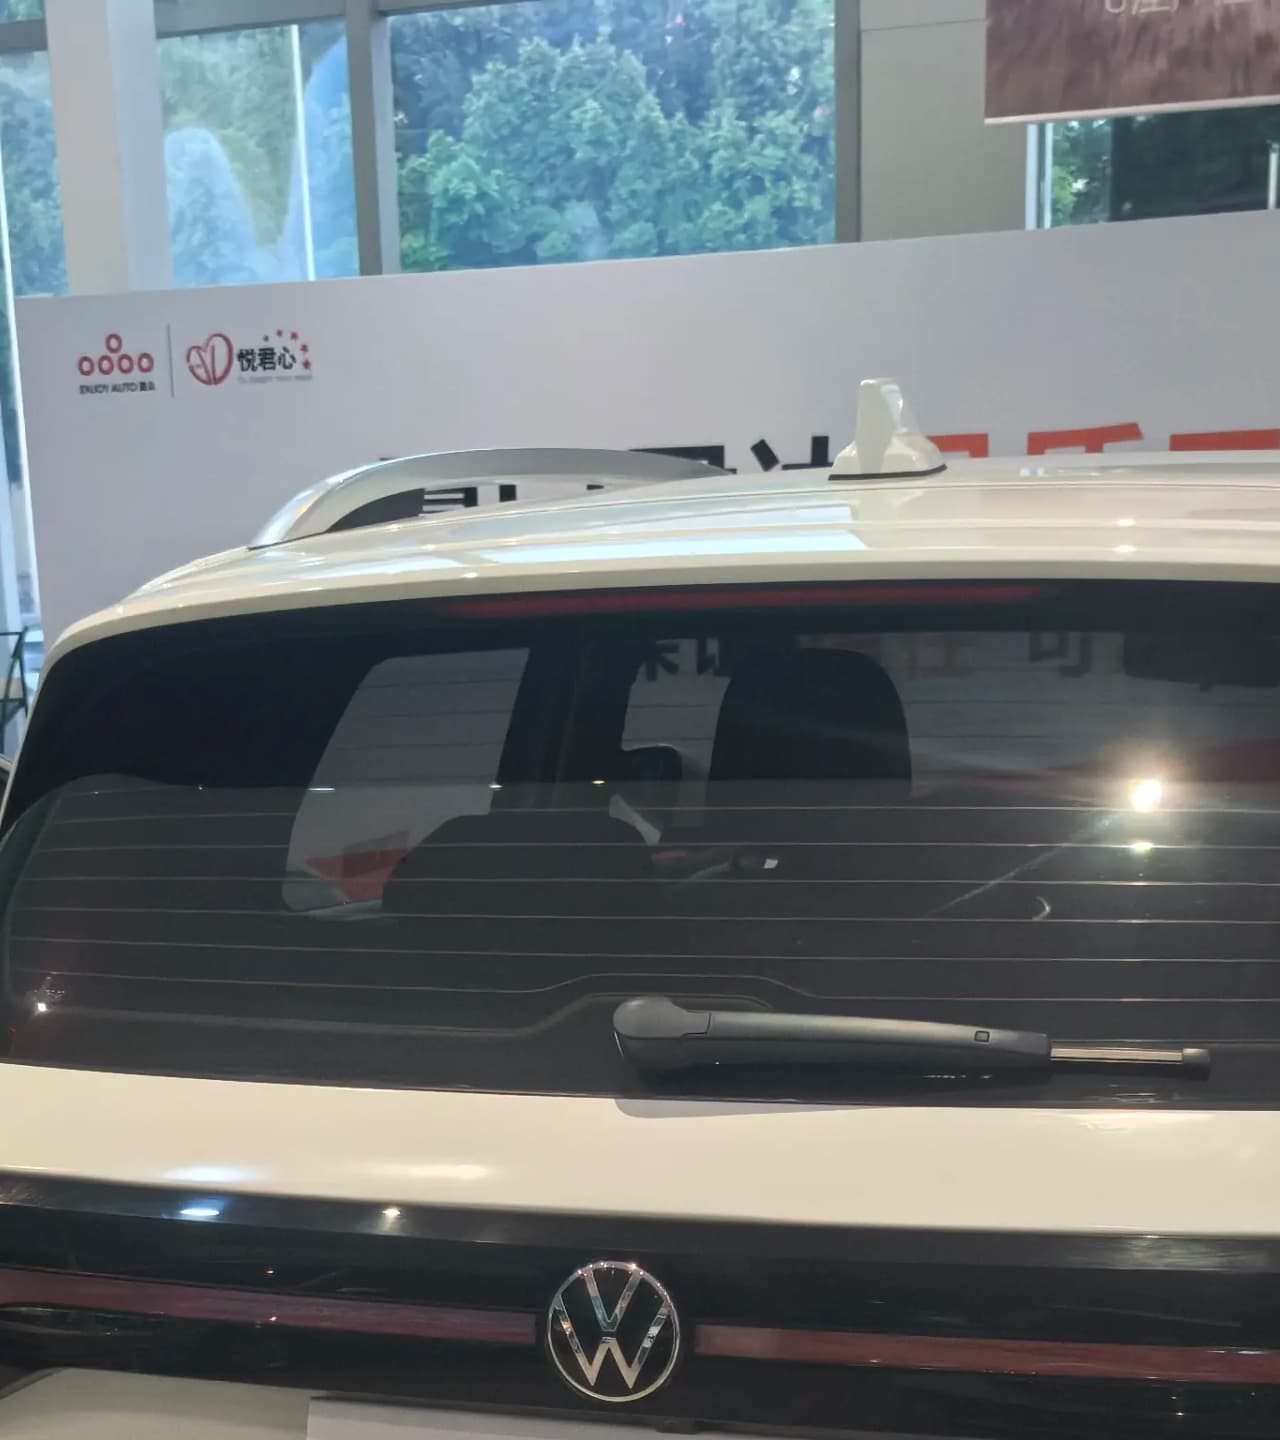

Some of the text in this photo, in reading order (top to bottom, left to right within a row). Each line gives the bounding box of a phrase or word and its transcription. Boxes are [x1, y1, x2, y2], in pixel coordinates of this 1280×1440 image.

[236, 346, 297, 372] 悦君心
[111, 382, 138, 393] AUTO
